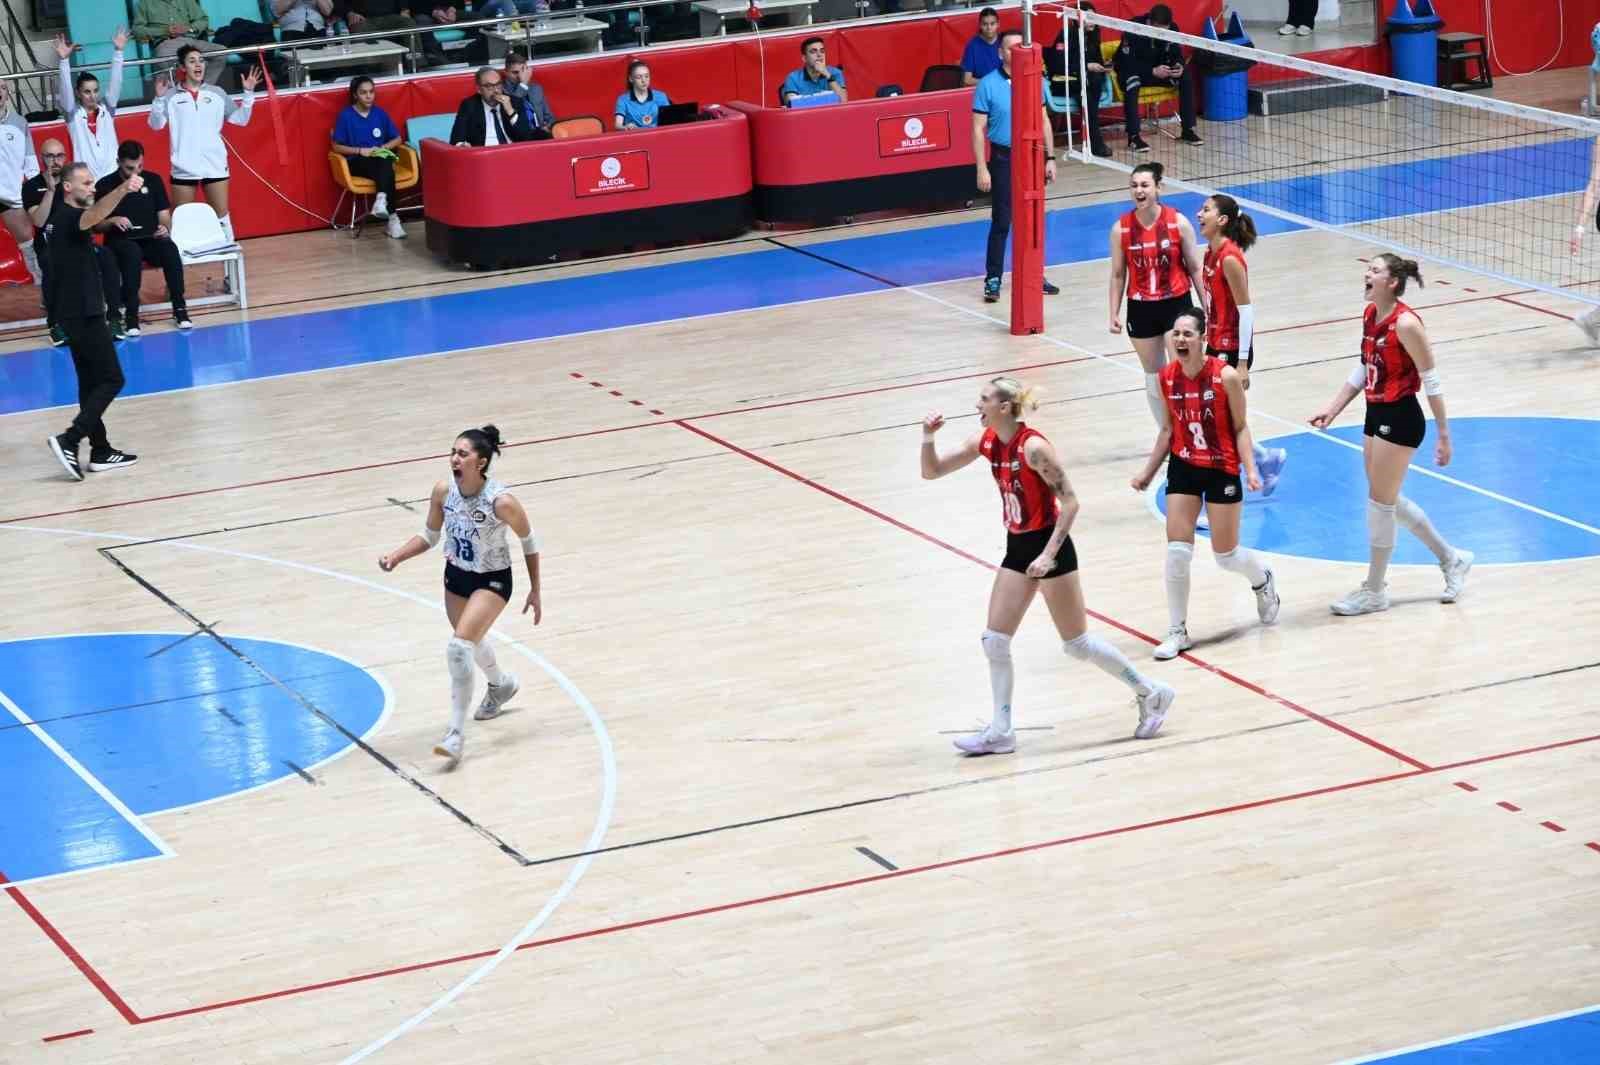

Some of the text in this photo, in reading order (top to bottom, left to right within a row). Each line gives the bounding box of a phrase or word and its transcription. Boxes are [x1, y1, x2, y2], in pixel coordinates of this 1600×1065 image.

[902, 136, 928, 148] BİLECİK
[598, 177, 627, 188] BİLECİK
[1188, 421, 1209, 450] 8
[453, 536, 475, 562] 13
